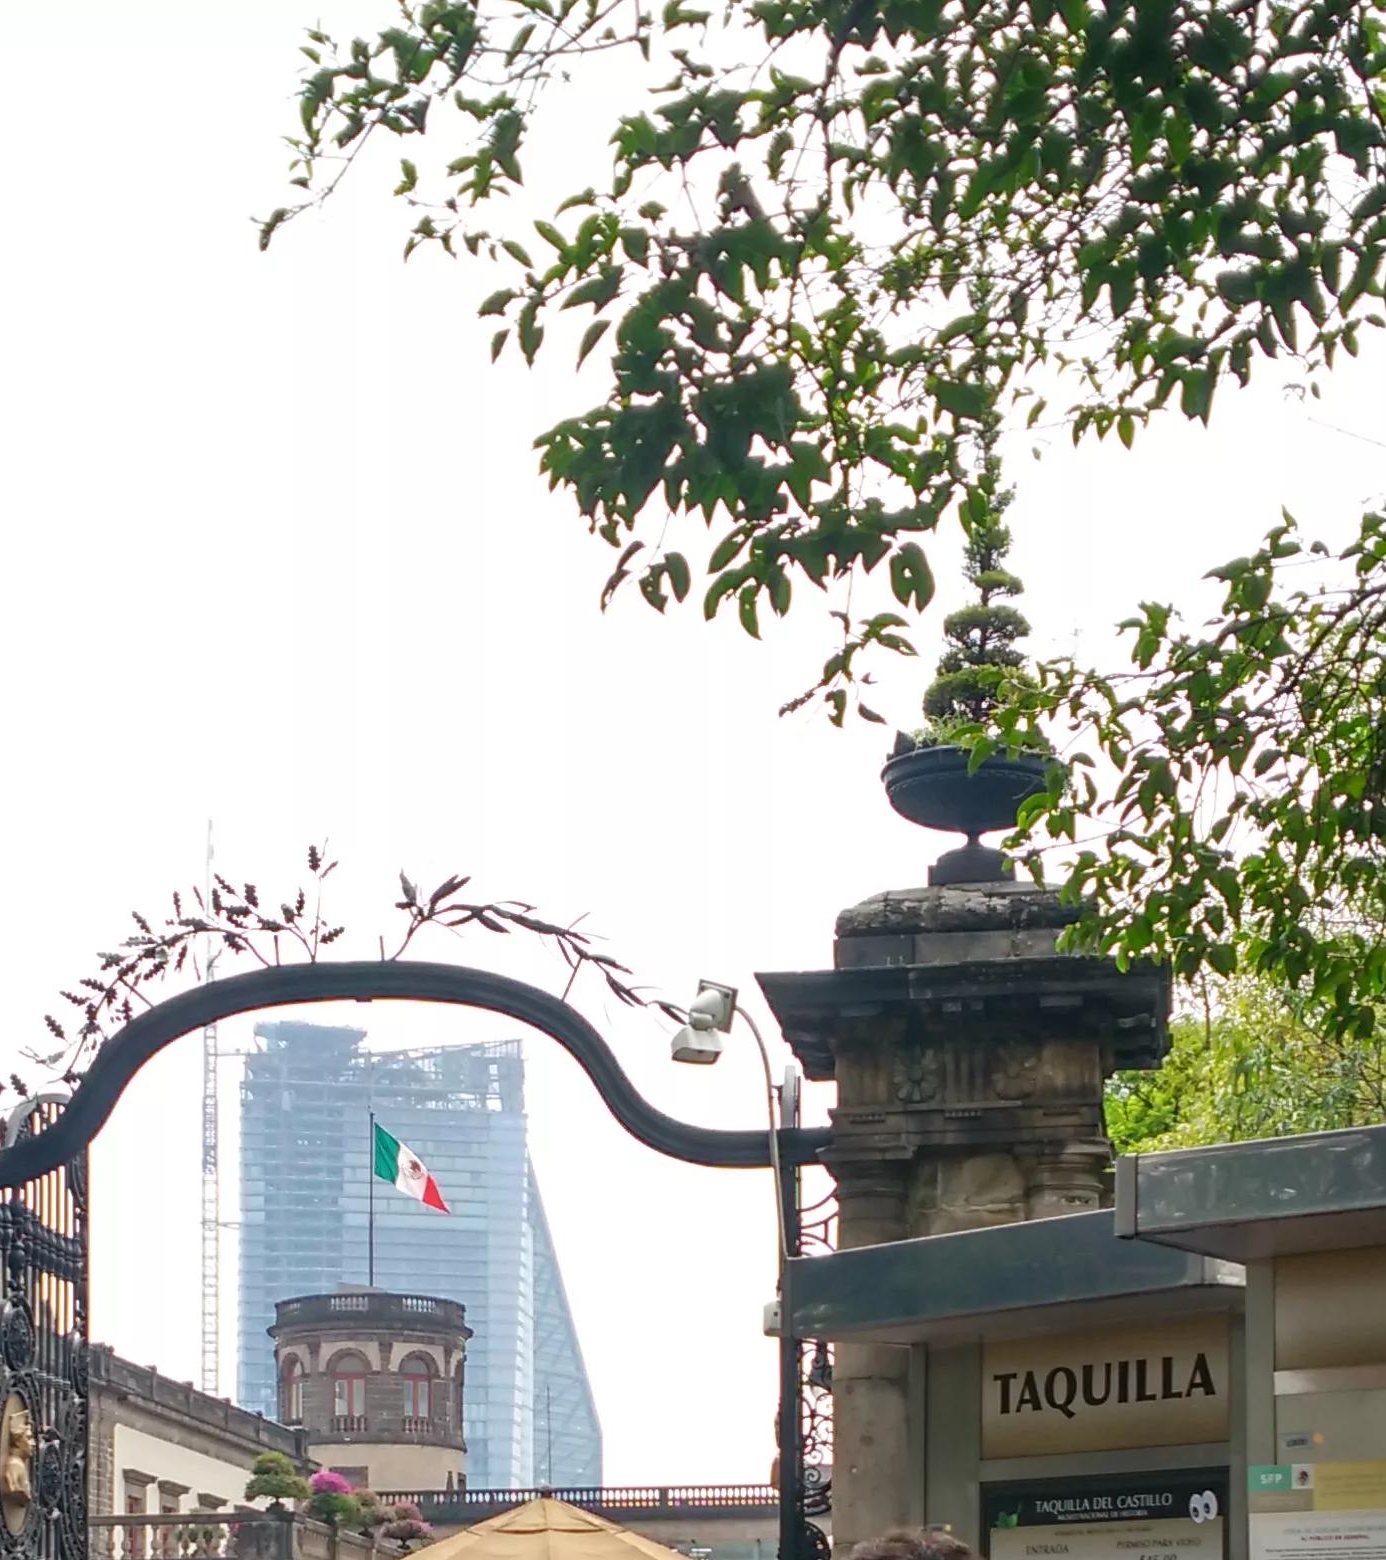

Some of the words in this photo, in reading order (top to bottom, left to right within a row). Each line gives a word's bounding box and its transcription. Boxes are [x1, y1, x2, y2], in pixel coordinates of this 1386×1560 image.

[993, 1353, 1217, 1419] TAQUILLA
[1260, 1473, 1283, 1485] SFP
[1034, 1497, 1090, 1516] TAQUILLA
[1092, 1496, 1113, 1510] DEL
[1116, 1492, 1173, 1509] CASTILLO
[1116, 1538, 1149, 1549] PERMISO
[1151, 1538, 1173, 1548] PARA
[1175, 1536, 1202, 1547] VIDEO
[1025, 1543, 1070, 1556] ENTRADA
